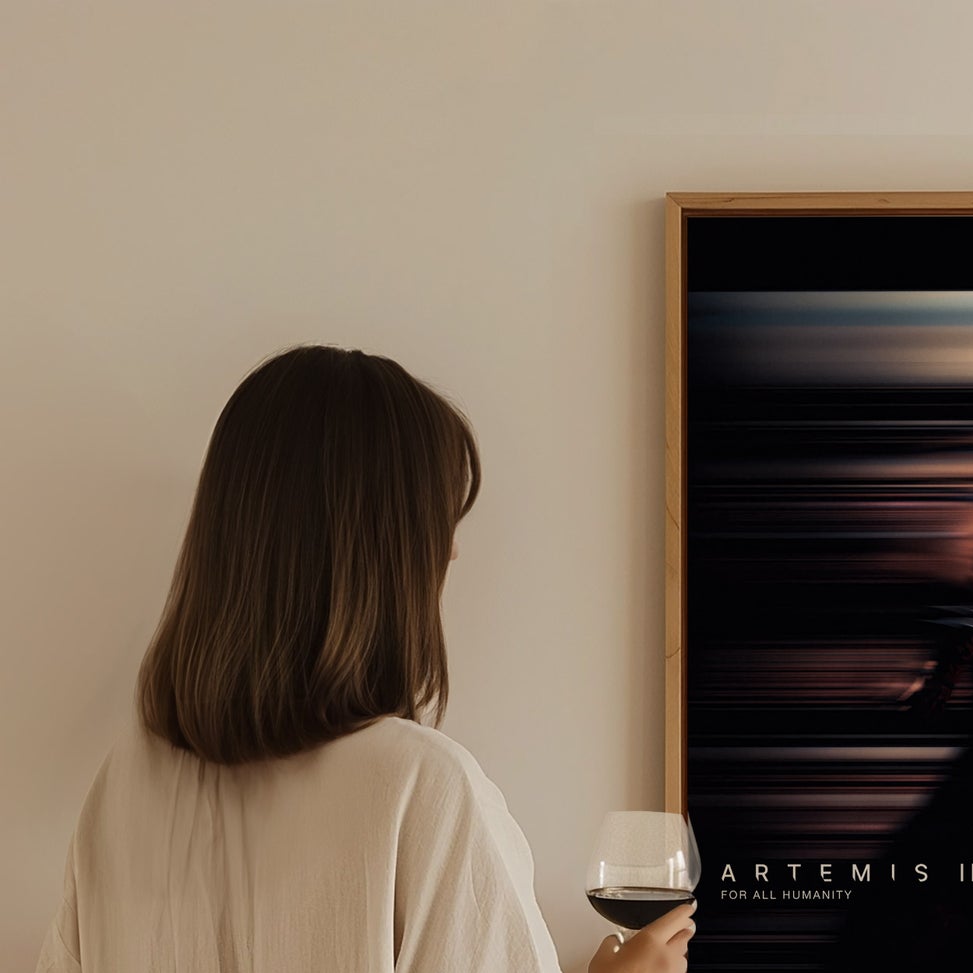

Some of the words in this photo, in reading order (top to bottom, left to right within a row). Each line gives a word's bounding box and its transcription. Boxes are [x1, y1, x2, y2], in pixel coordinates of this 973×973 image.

[721, 863, 928, 882] ARTEMIS
[721, 890, 747, 900] FOR
[752, 890, 777, 900] ALL
[783, 890, 852, 900] HUMANITY
